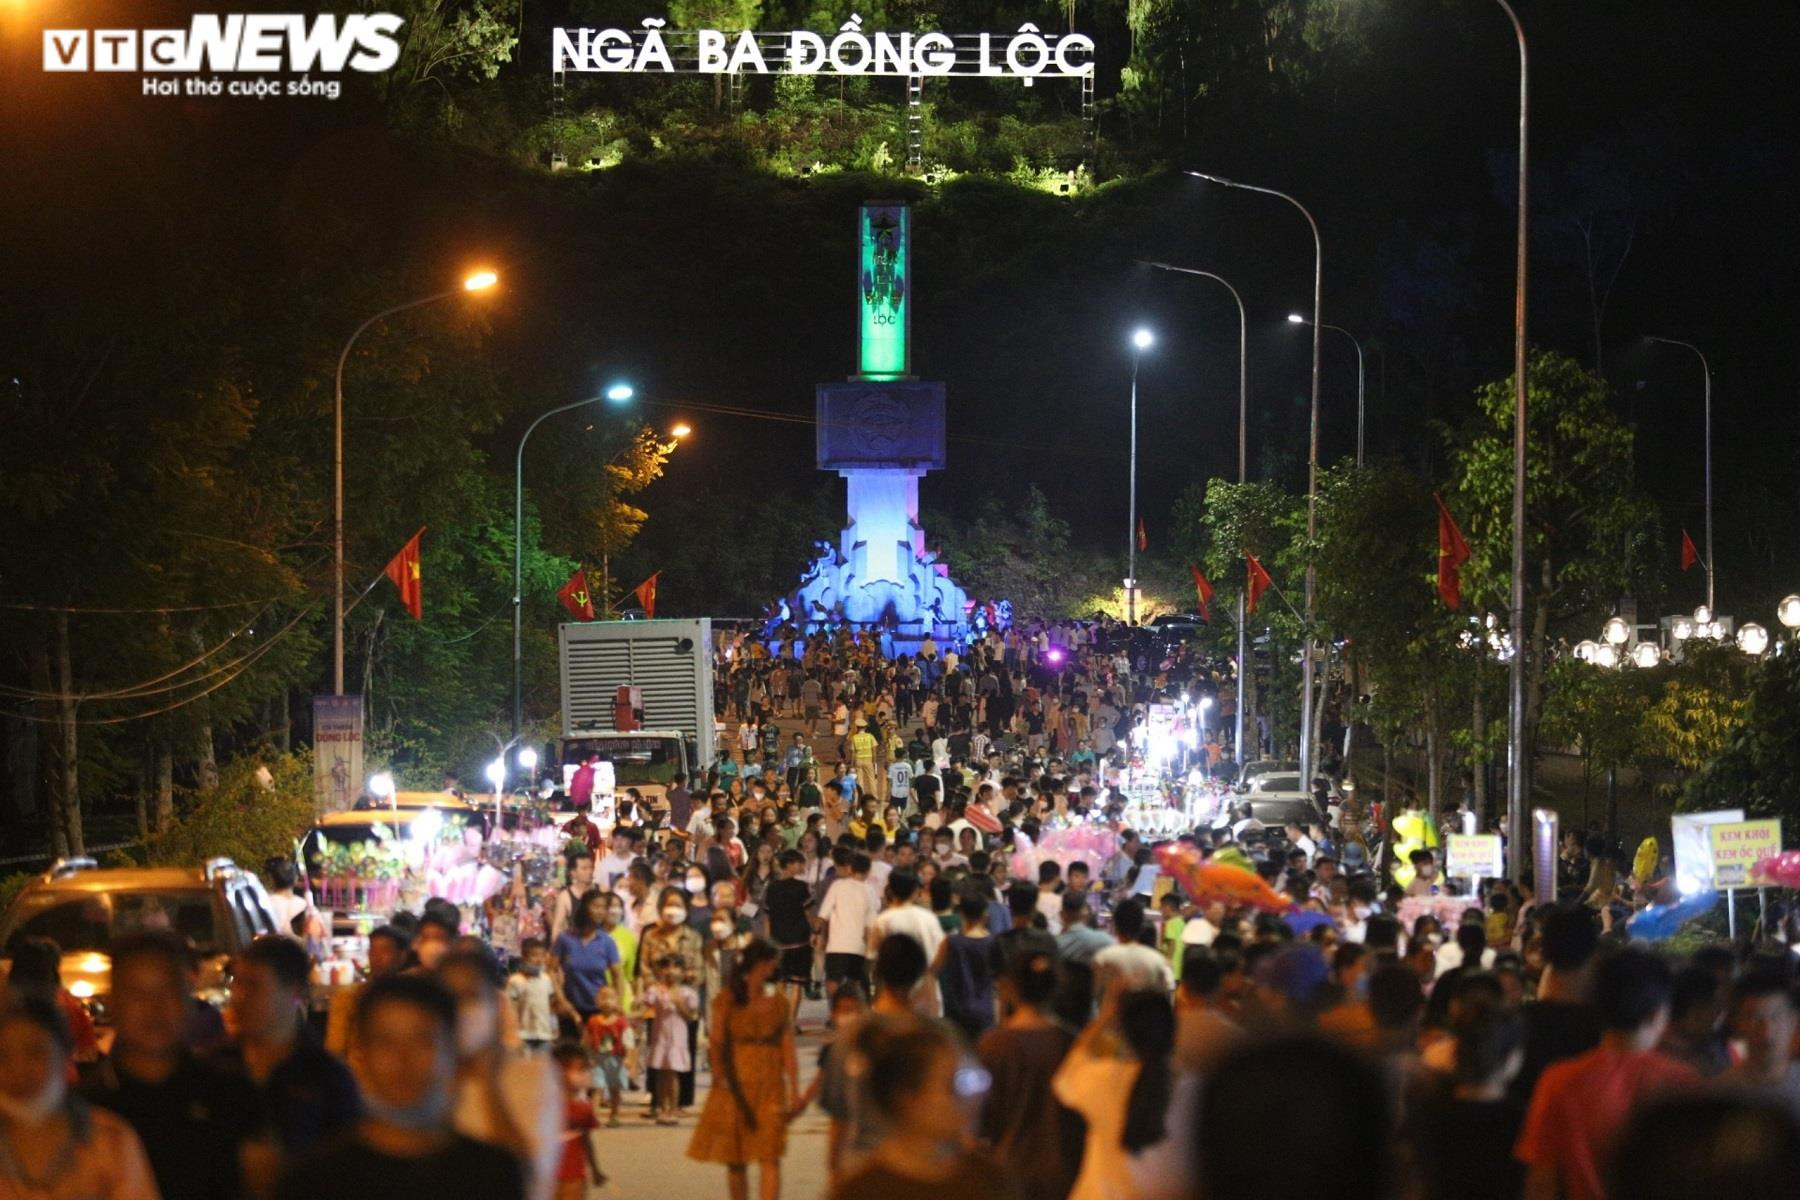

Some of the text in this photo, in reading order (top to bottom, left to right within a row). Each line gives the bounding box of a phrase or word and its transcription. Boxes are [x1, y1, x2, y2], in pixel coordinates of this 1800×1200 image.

[553, 13, 1095, 87] NGÃ BA ĐỒNG LỘC
